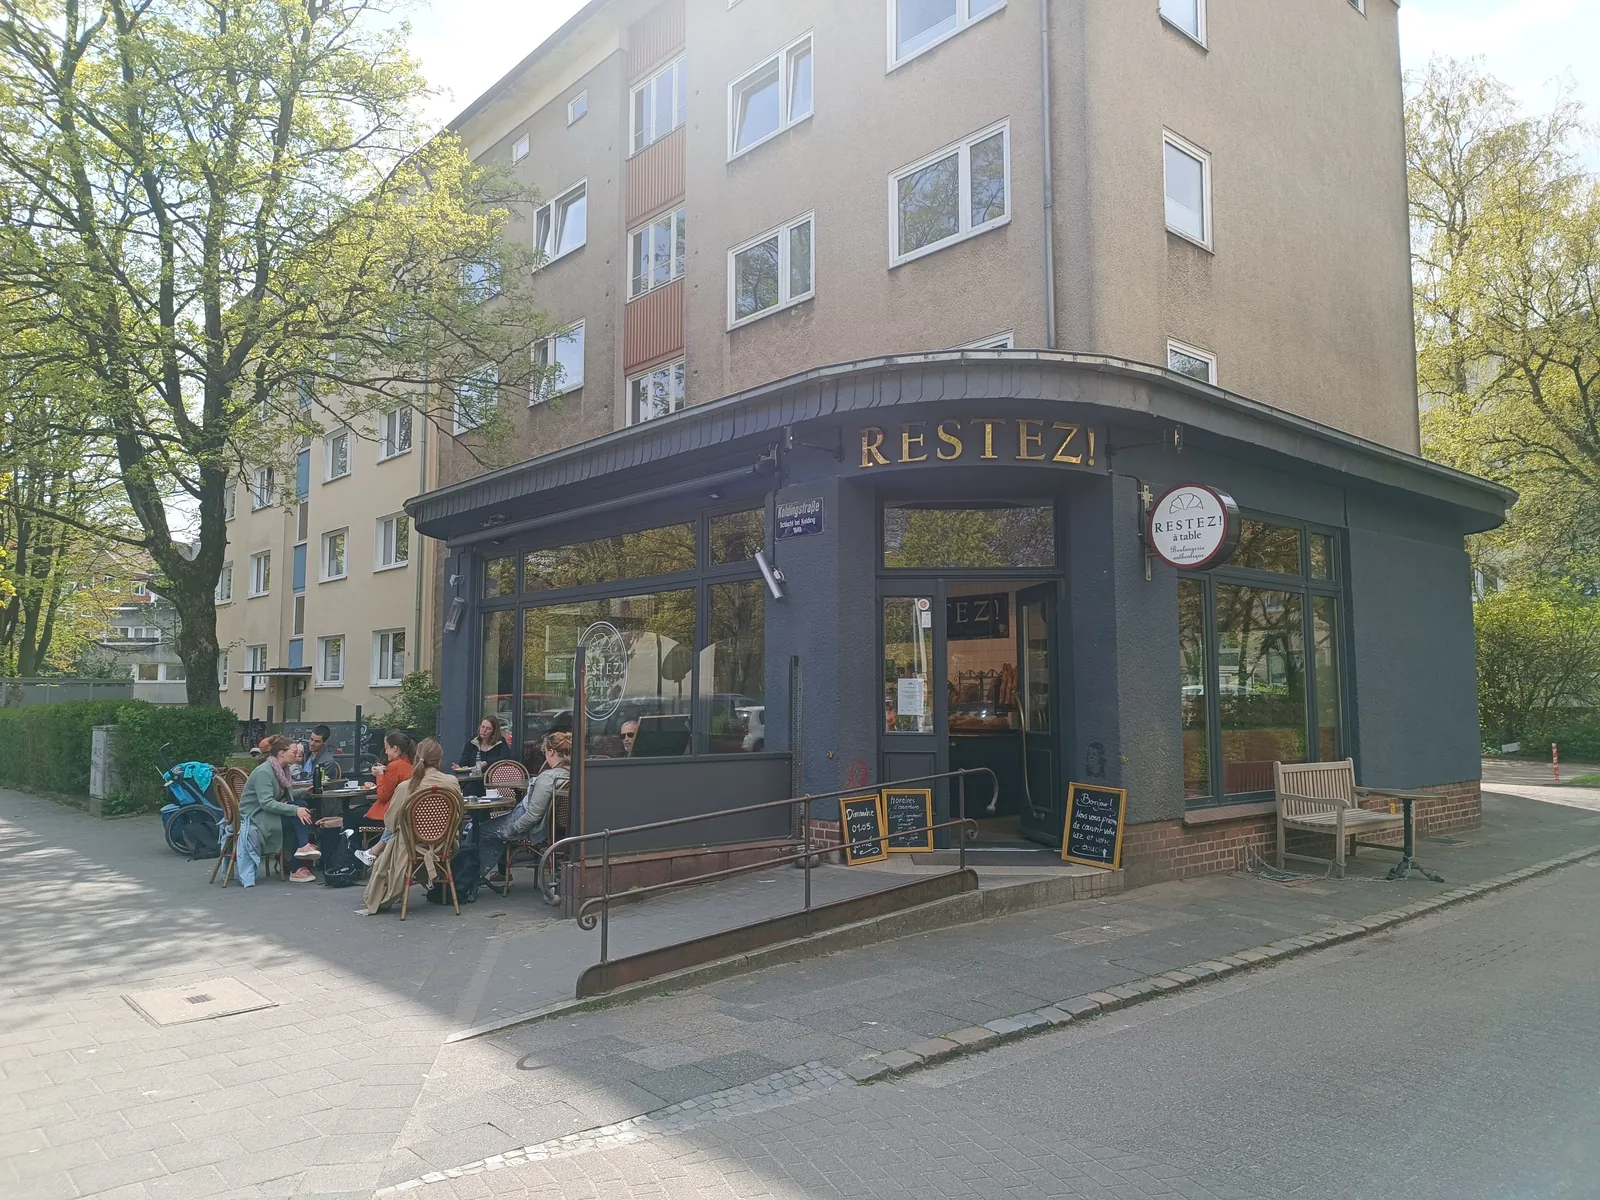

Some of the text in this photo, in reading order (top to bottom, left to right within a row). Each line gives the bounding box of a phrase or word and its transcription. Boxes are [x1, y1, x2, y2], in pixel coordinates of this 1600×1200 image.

[858, 418, 1097, 468] RESTEZ!
[778, 500, 820, 519] Koldingstraße
[1154, 516, 1222, 533] RESTEZ!
[1173, 530, 1202, 542] à table
[947, 600, 999, 623] EZ!
[585, 661, 624, 675] ESTEZ!
[846, 808, 874, 820] Dimanche
